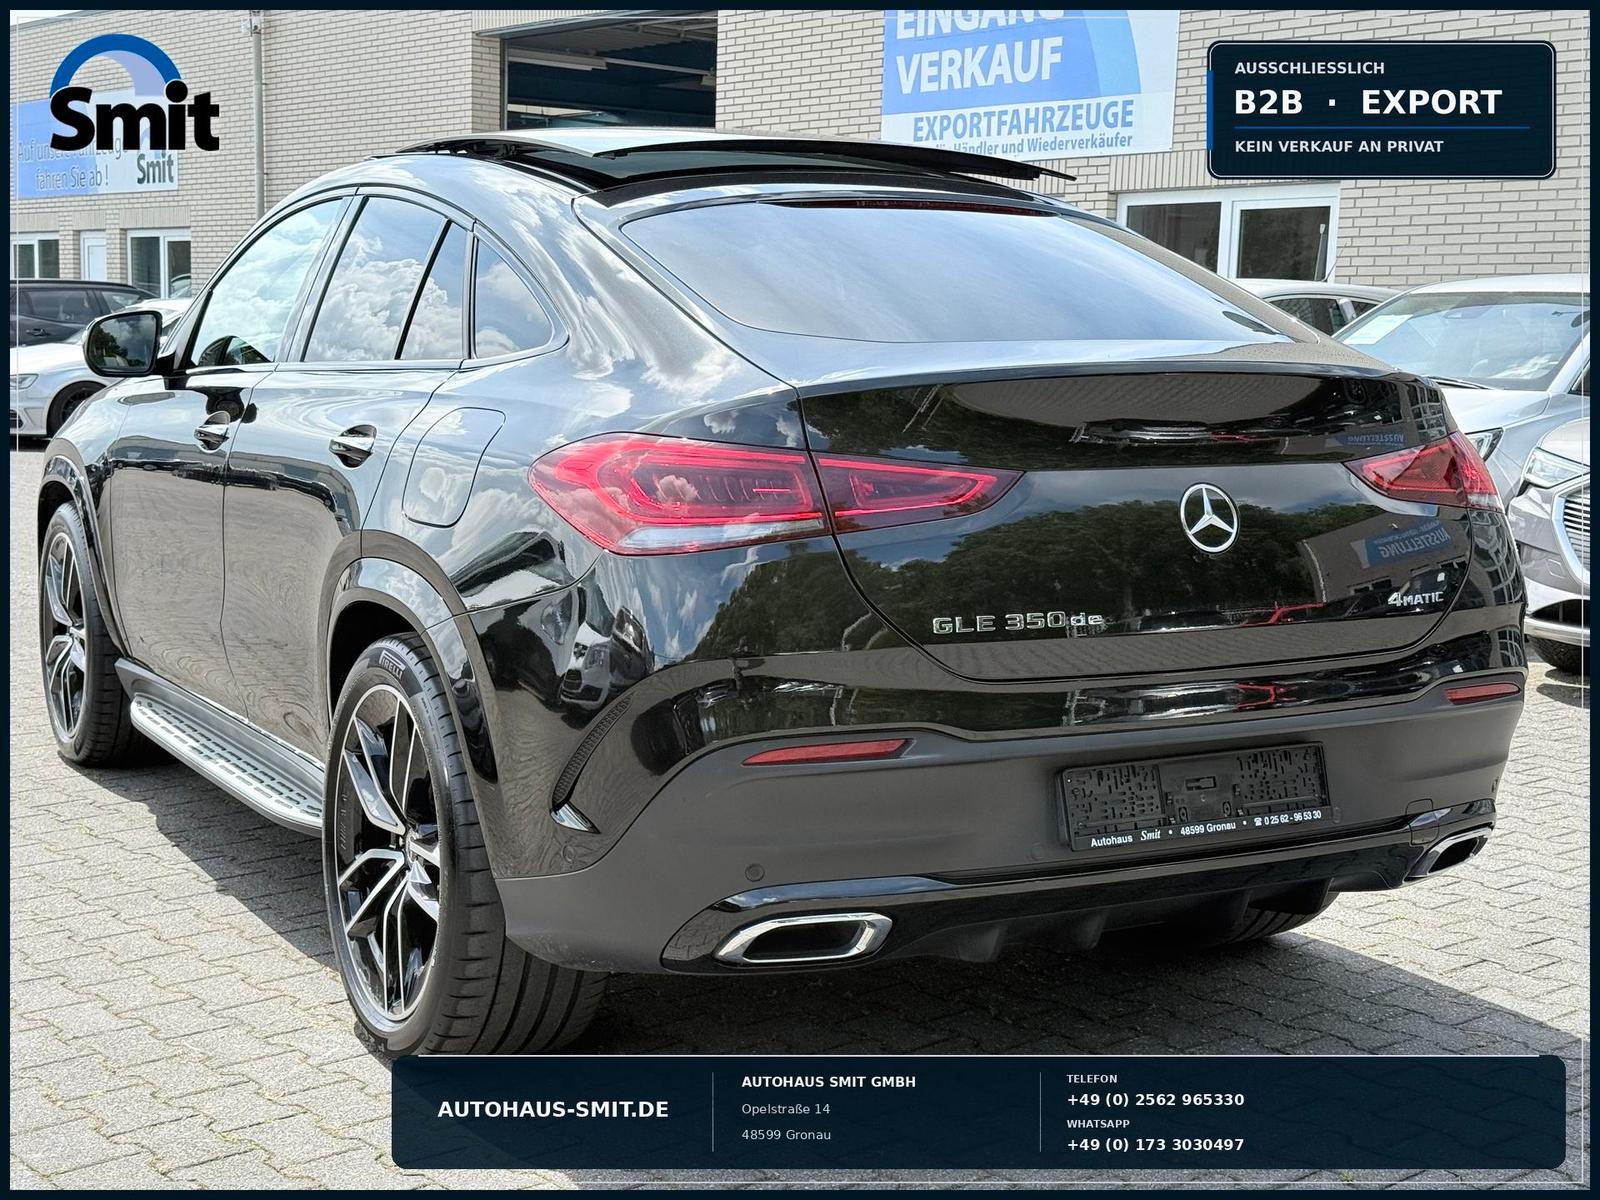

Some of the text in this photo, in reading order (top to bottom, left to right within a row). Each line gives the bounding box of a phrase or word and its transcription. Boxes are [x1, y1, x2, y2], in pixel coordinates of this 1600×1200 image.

[896, 36, 1064, 95] VERKAUF
[912, 99, 1135, 142] EXPORTFAHRZEUGE
[1001, 143, 1024, 154] und
[1027, 131, 1133, 152] Wiederverkäufer
[35, 165, 68, 192] fahren
[70, 165, 87, 189] Sie
[136, 149, 175, 185] Smit
[1387, 591, 1444, 607] 4MATIC
[932, 615, 997, 634] GLE
[378, 650, 405, 680] PIRELLI
[1090, 834, 1133, 848] Autohaus
[1140, 828, 1161, 841] Smit
[1180, 824, 1205, 836] 48599
[1206, 821, 1236, 833] Gronau
